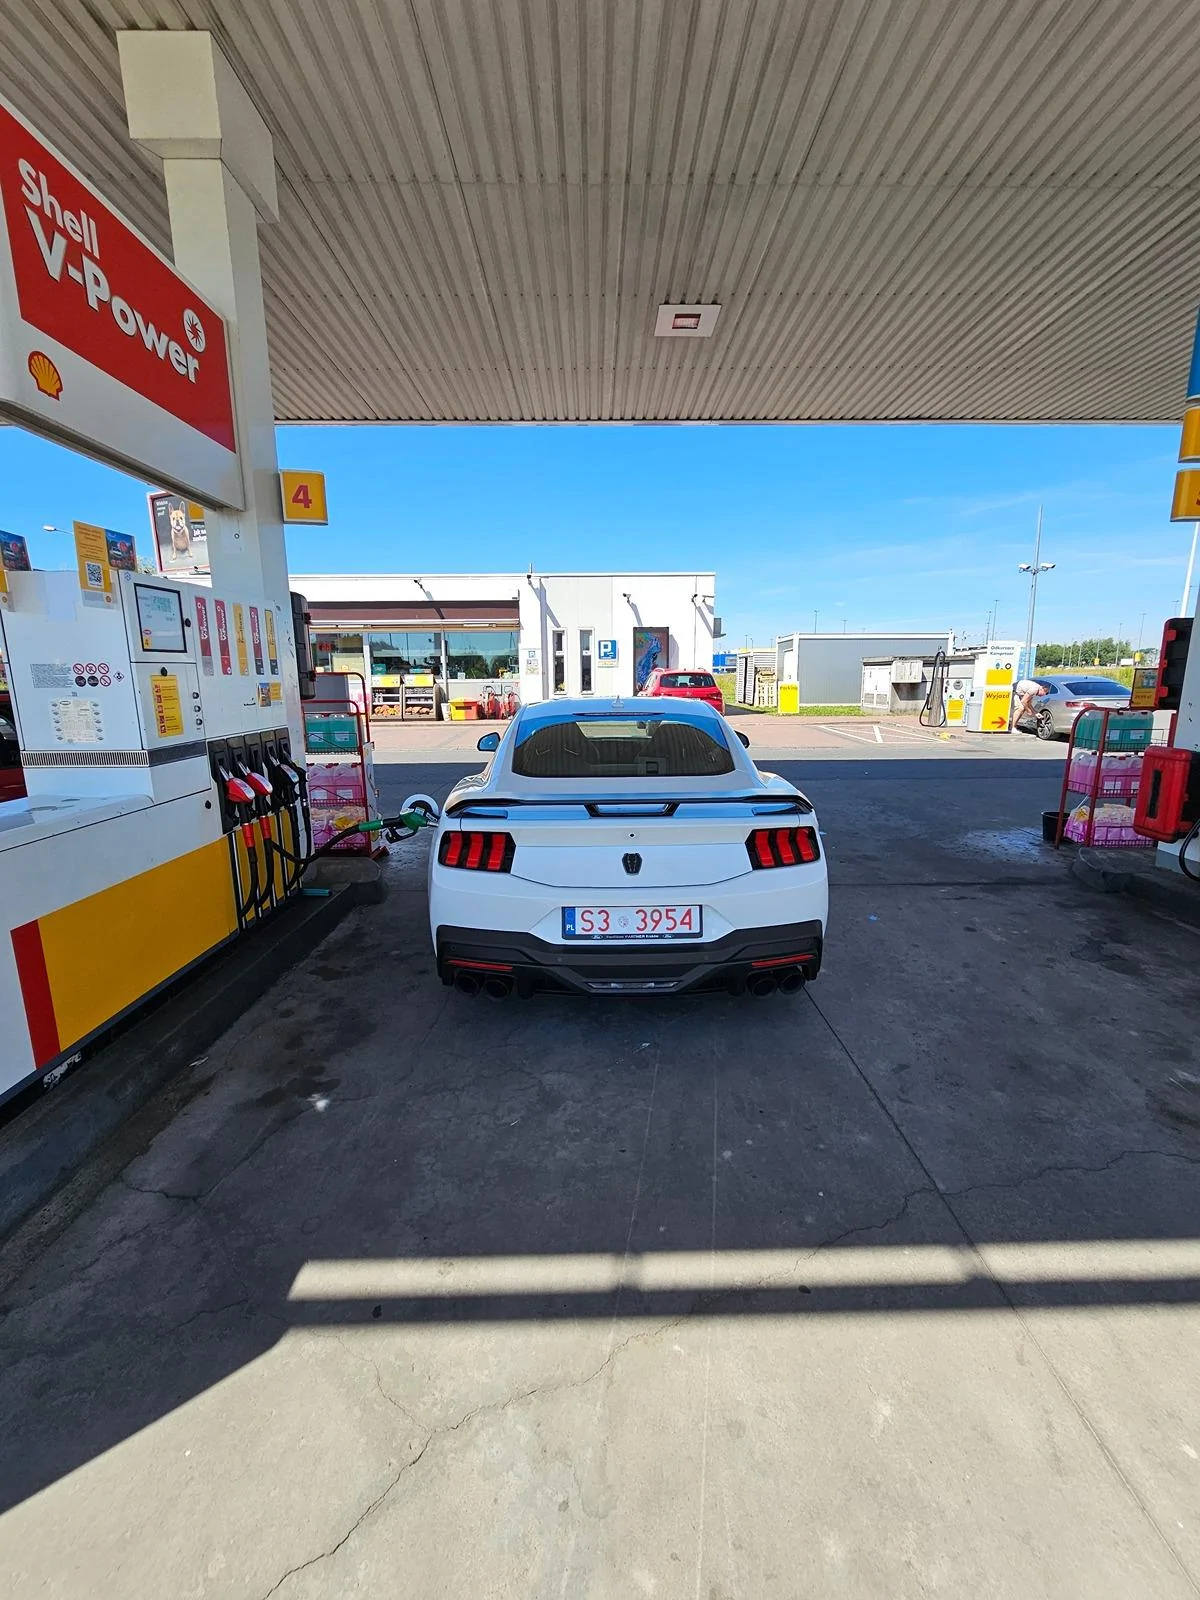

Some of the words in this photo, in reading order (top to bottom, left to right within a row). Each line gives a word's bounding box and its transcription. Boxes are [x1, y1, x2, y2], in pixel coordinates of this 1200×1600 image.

[18, 158, 100, 260] Shell
[24, 203, 200, 384] V-Power
[291, 484, 313, 509] 4
[600, 641, 612, 657] P
[986, 692, 1010, 700] Wyjazd
[580, 909, 610, 932] S3
[635, 907, 693, 931] 3954
